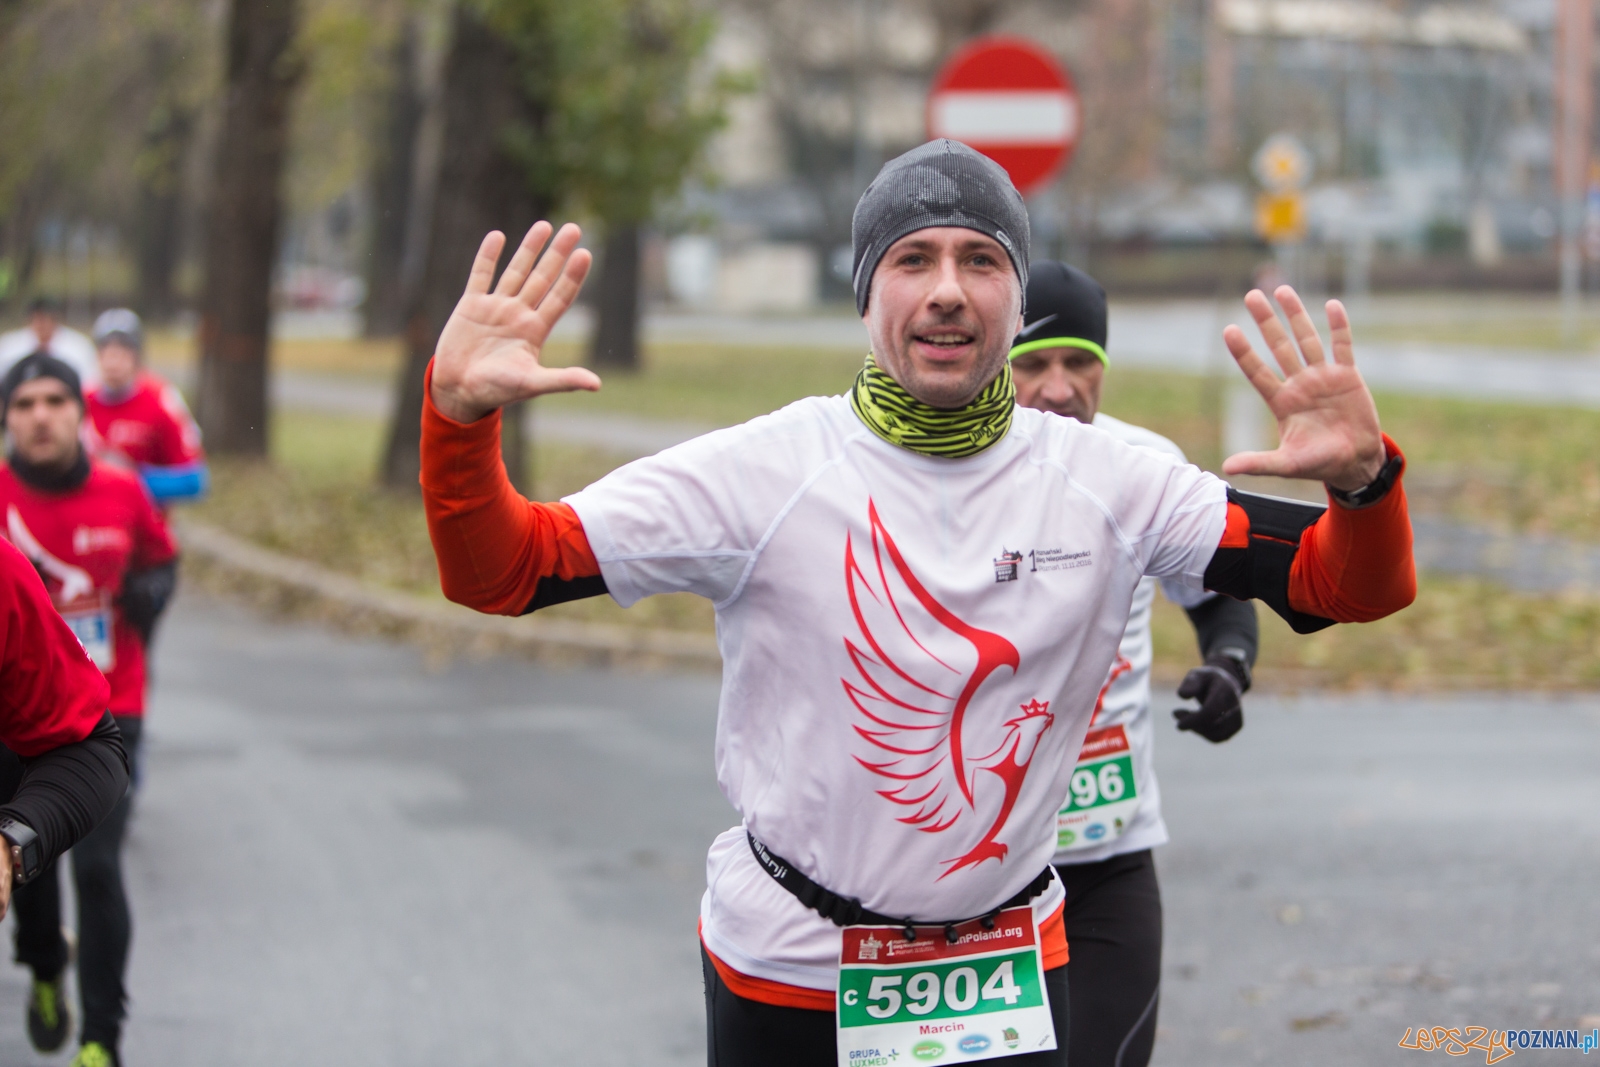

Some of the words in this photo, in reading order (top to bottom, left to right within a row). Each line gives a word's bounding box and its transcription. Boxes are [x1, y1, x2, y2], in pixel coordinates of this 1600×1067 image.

[1029, 549, 1037, 572] 1
[865, 960, 1022, 1019] 5904
[919, 1023, 965, 1035] Marcin
[849, 1048, 881, 1059] GRUPA
[849, 1057, 888, 1067] LUXMED
